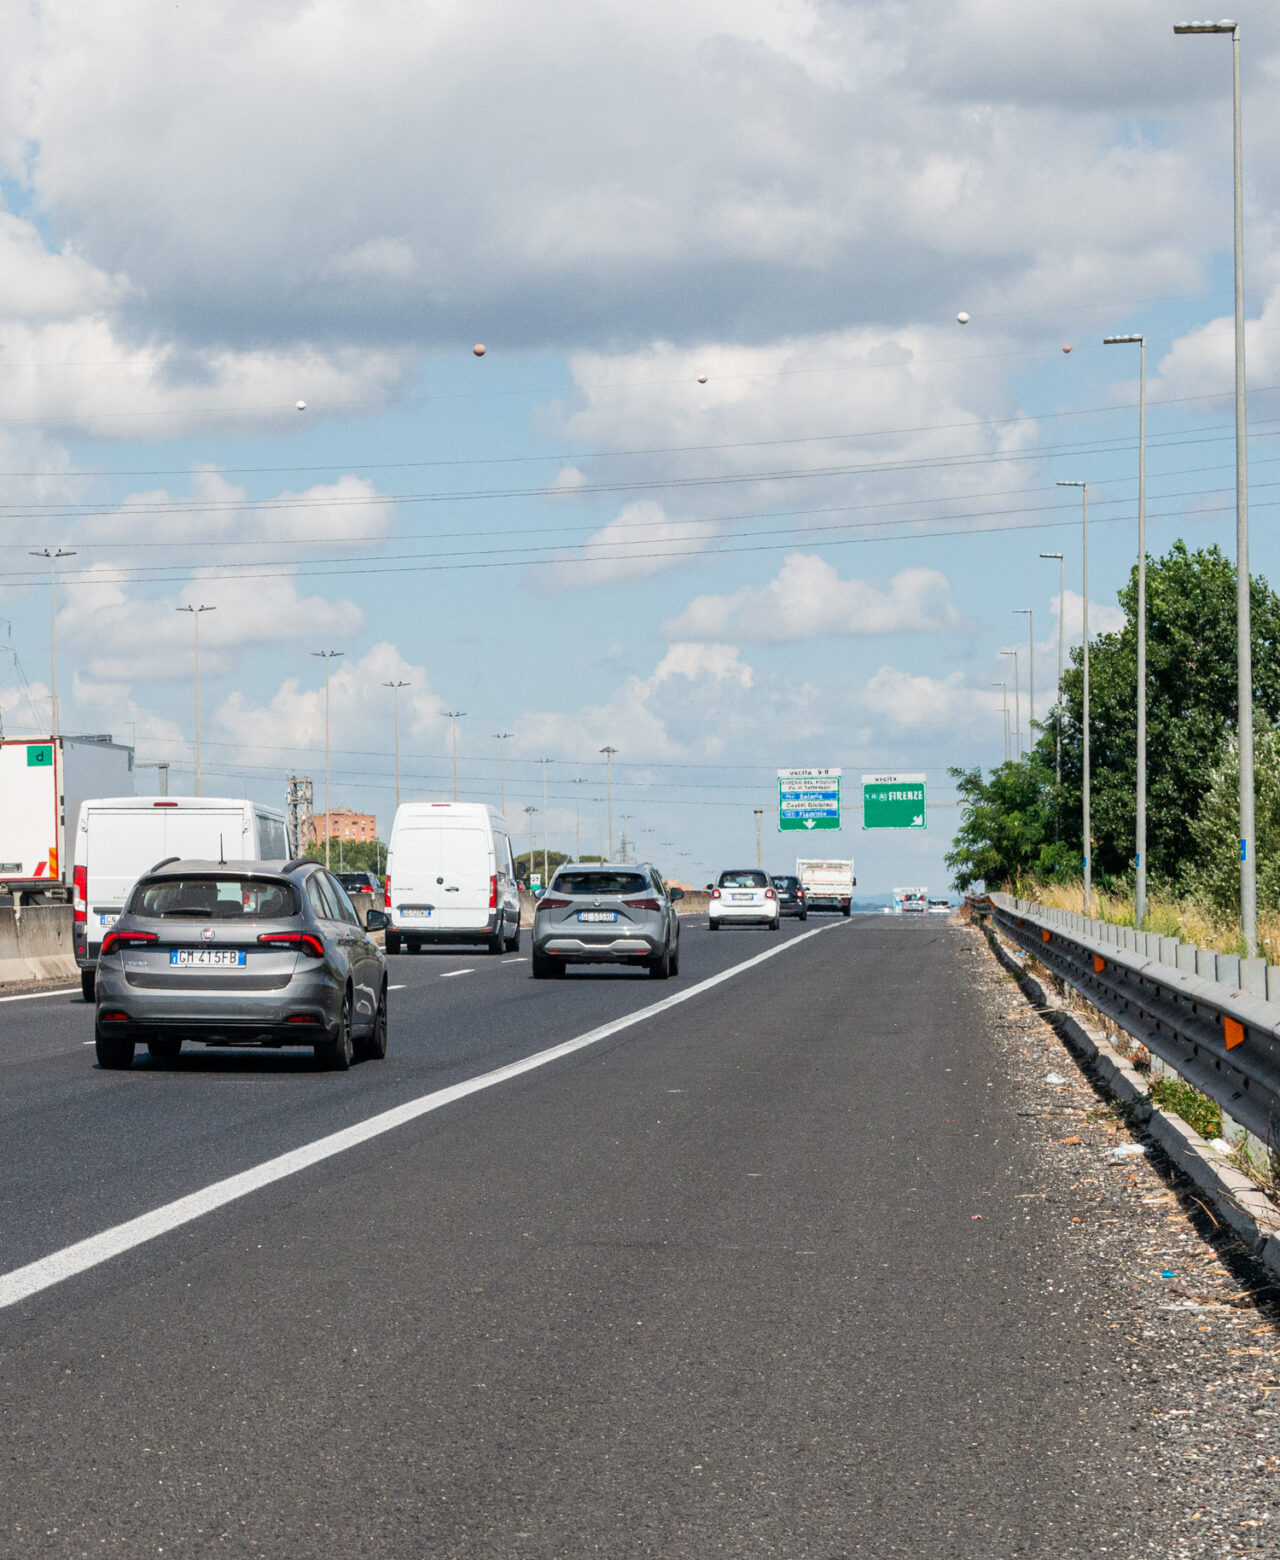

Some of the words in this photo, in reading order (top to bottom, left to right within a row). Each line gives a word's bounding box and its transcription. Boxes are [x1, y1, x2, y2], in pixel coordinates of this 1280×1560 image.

[36, 751, 44, 762] d
[889, 791, 923, 800] FIRENZE
[180, 951, 194, 963] GM
[199, 951, 237, 963] 415FB
